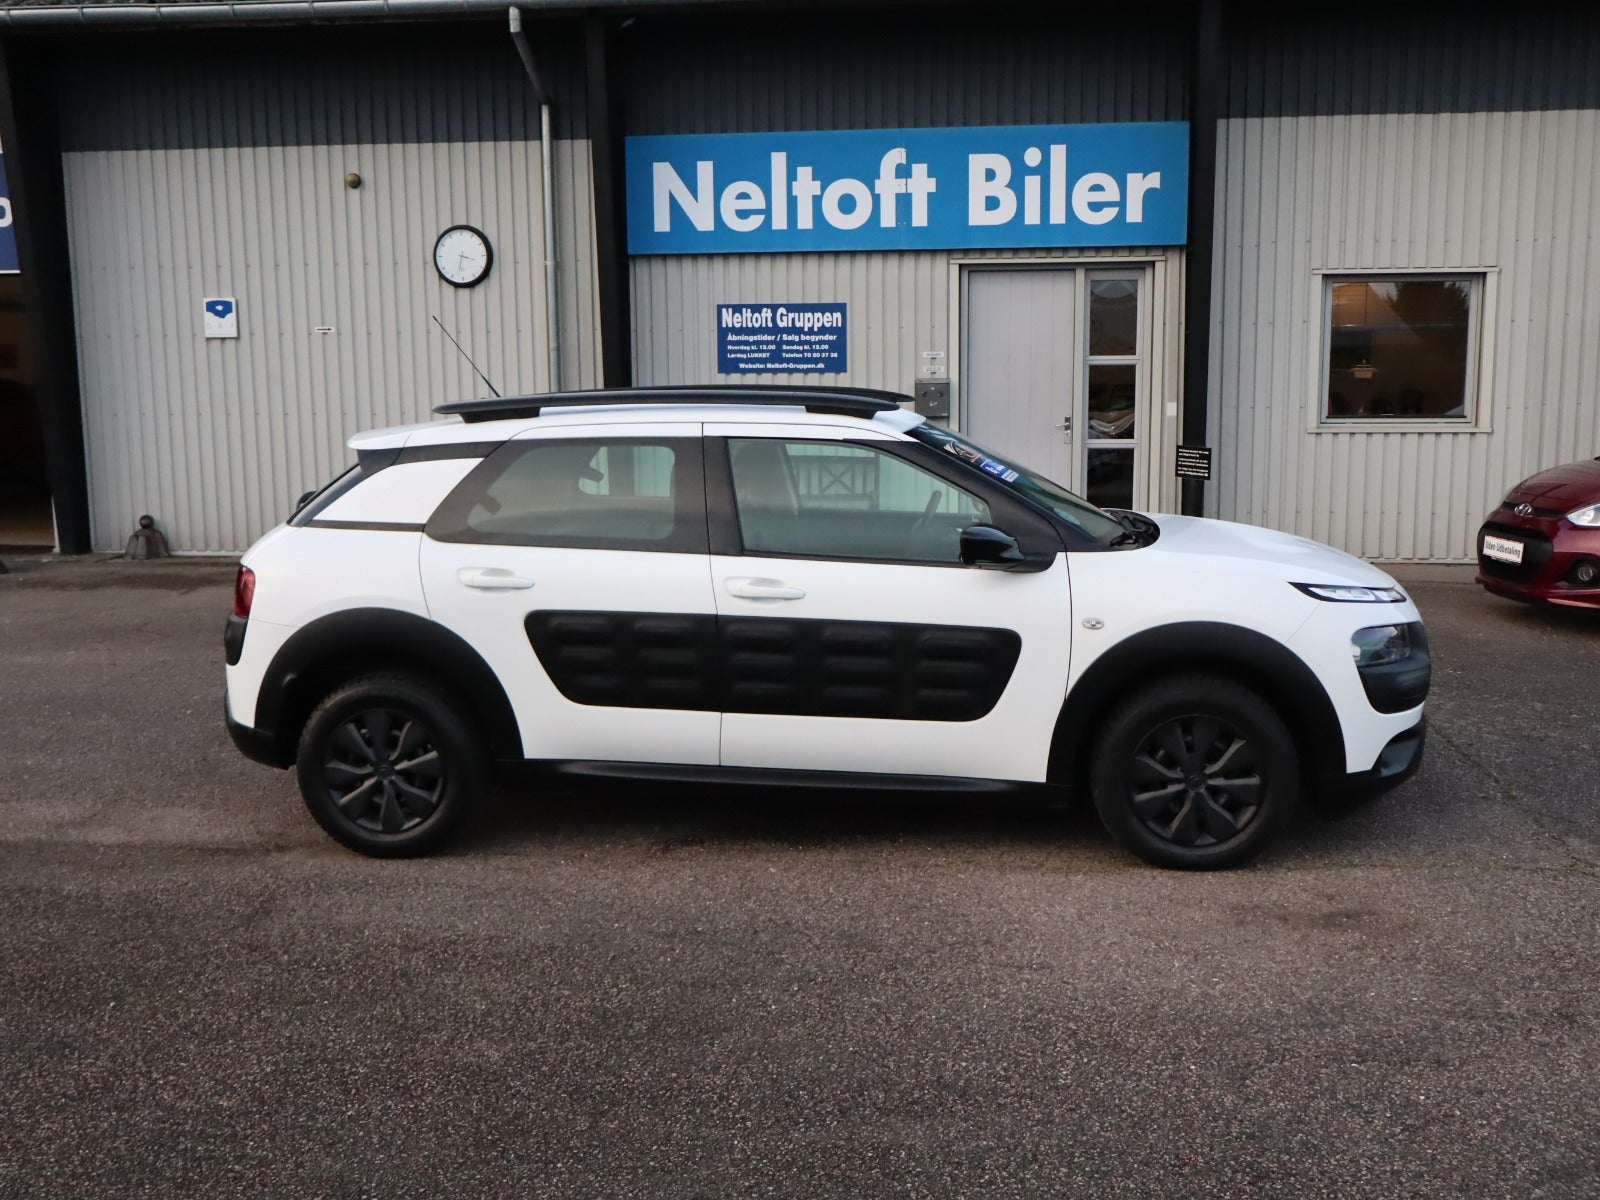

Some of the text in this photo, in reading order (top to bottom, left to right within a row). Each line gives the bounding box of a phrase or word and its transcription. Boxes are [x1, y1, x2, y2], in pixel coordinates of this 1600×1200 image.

[652, 144, 1161, 232] Neltoft Biler
[721, 307, 842, 331] Neltoft Gruppen
[727, 332, 776, 342] Åbningstider
[782, 334, 799, 342] Salg
[801, 334, 837, 342] begynder
